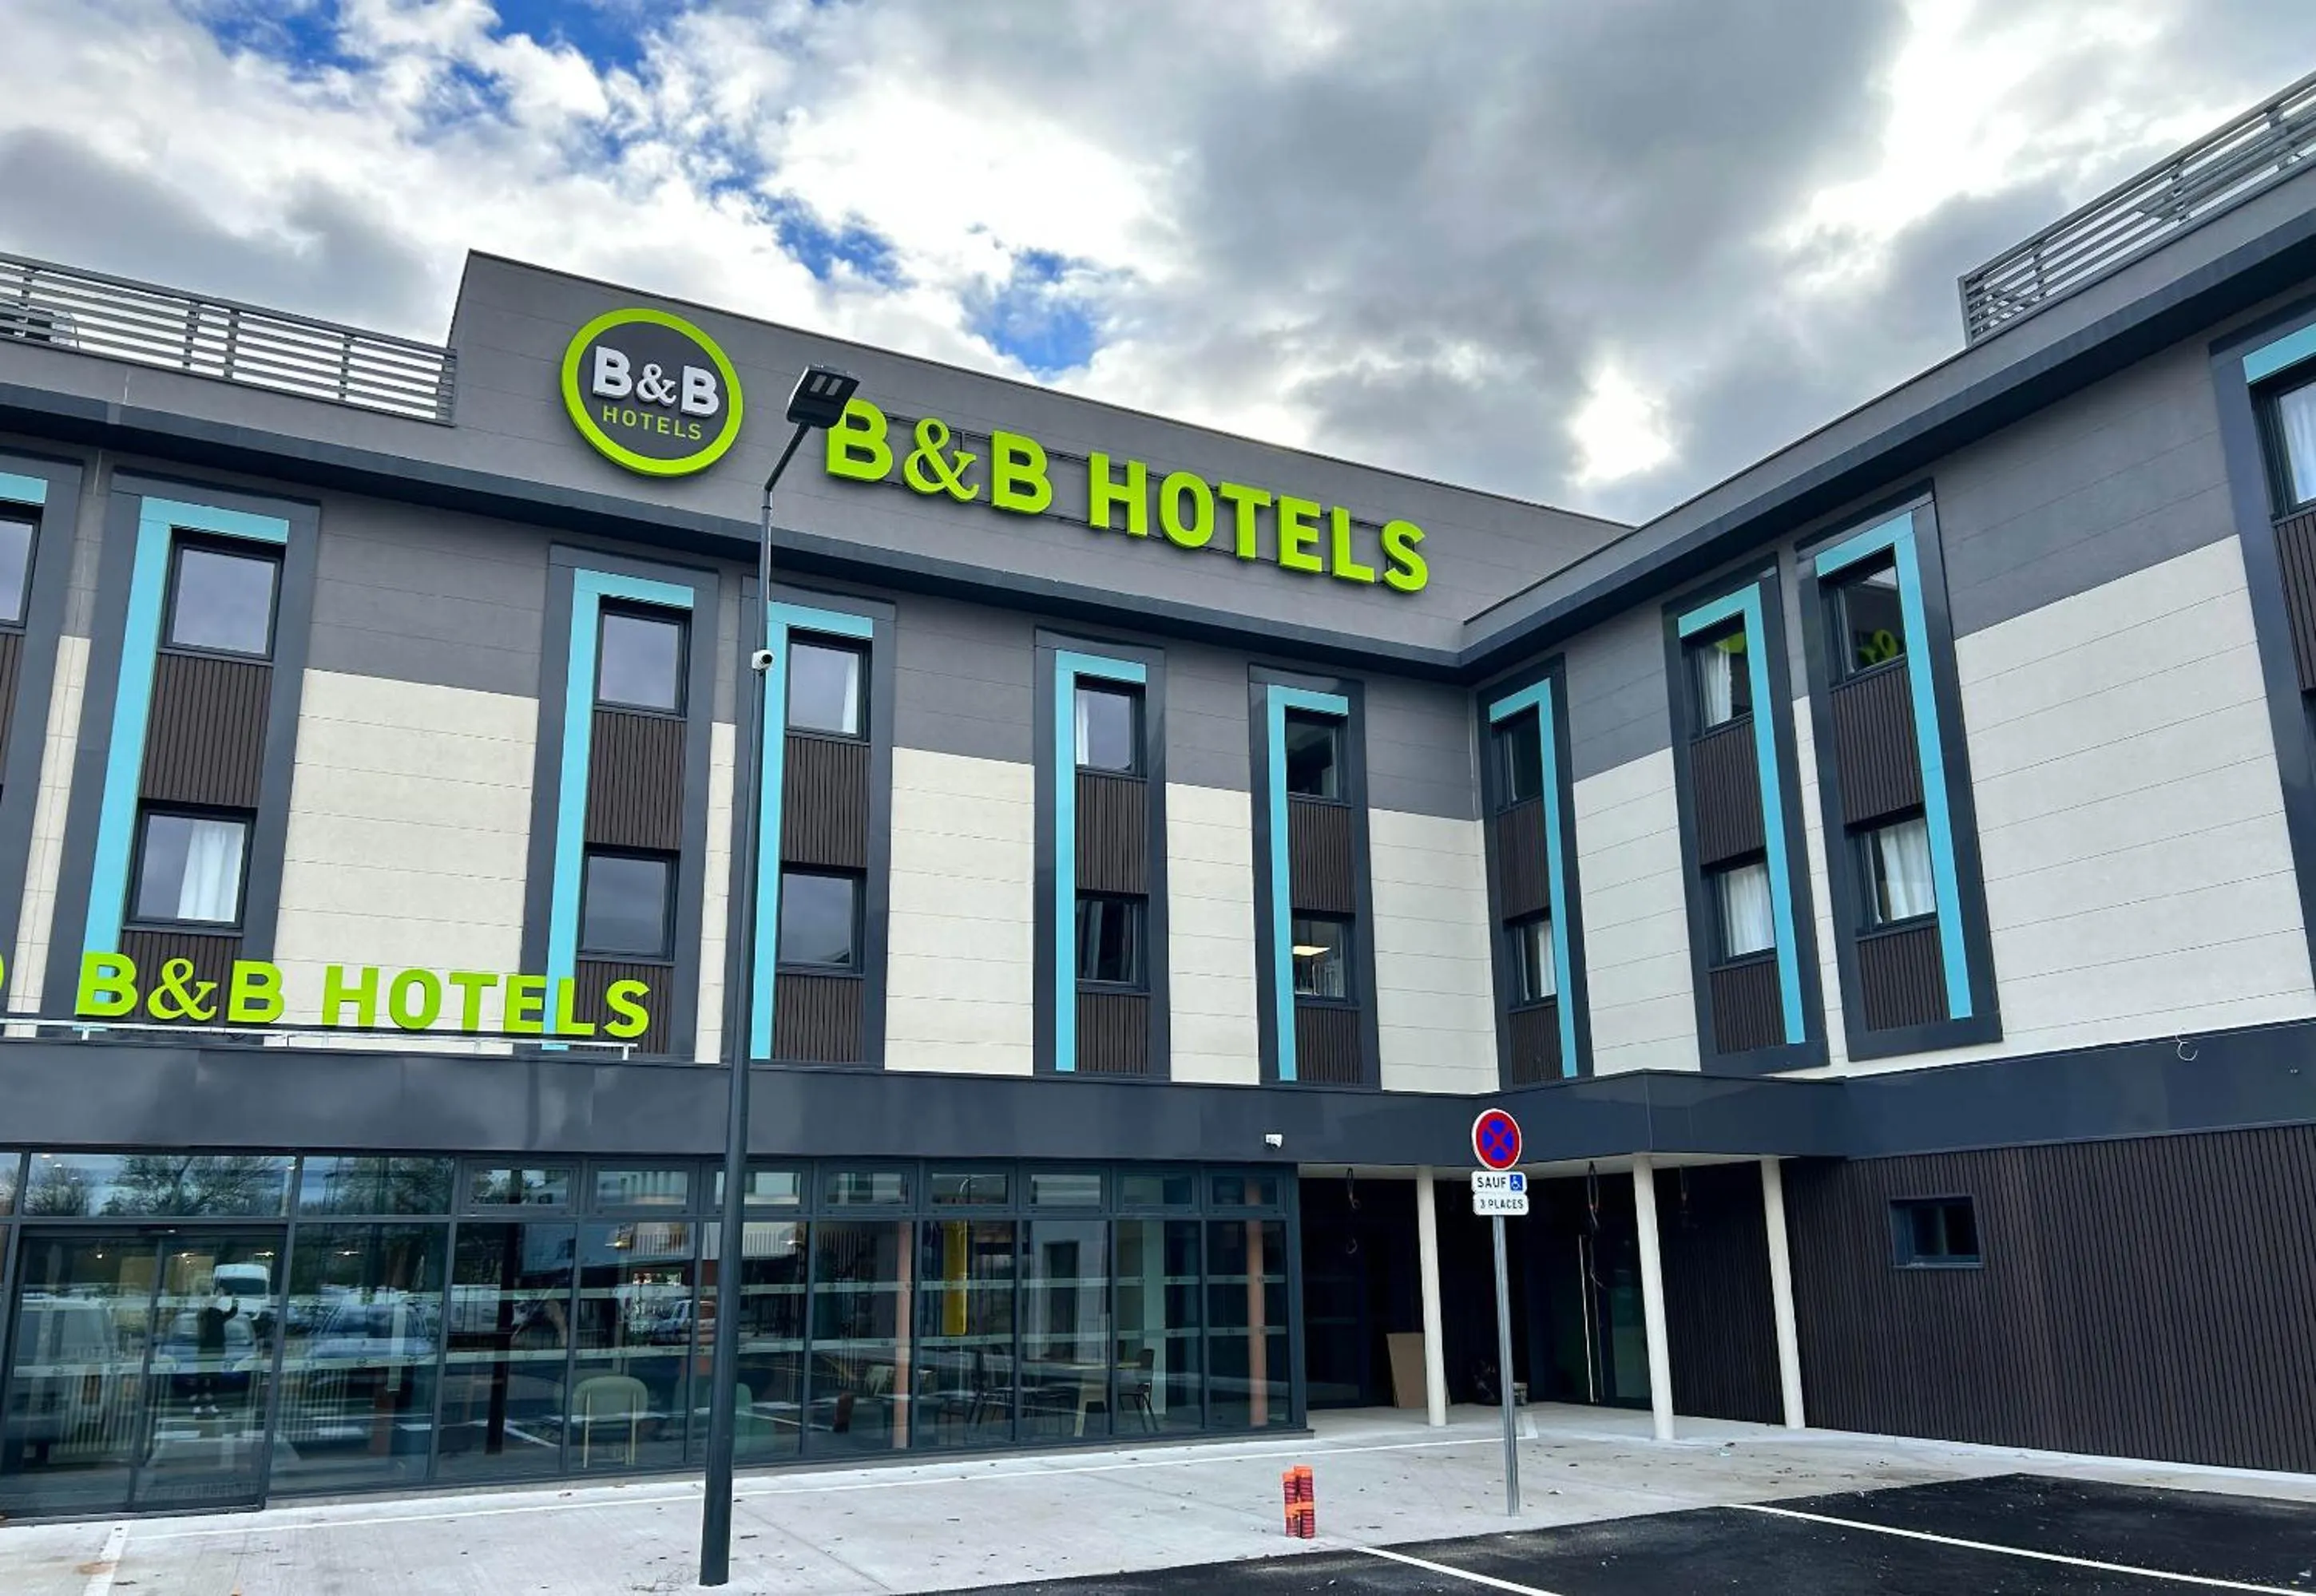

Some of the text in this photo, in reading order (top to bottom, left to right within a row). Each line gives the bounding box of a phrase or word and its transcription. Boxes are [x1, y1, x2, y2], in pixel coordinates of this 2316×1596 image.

[592, 346, 720, 418] B&B
[602, 405, 702, 440] HOTELS
[826, 398, 1429, 592] B&B HOTELS
[74, 952, 651, 1038] B&B HOTELS
[1477, 1177, 1507, 1188] SAUF
[1480, 1199, 1524, 1209] 3 PLACES
